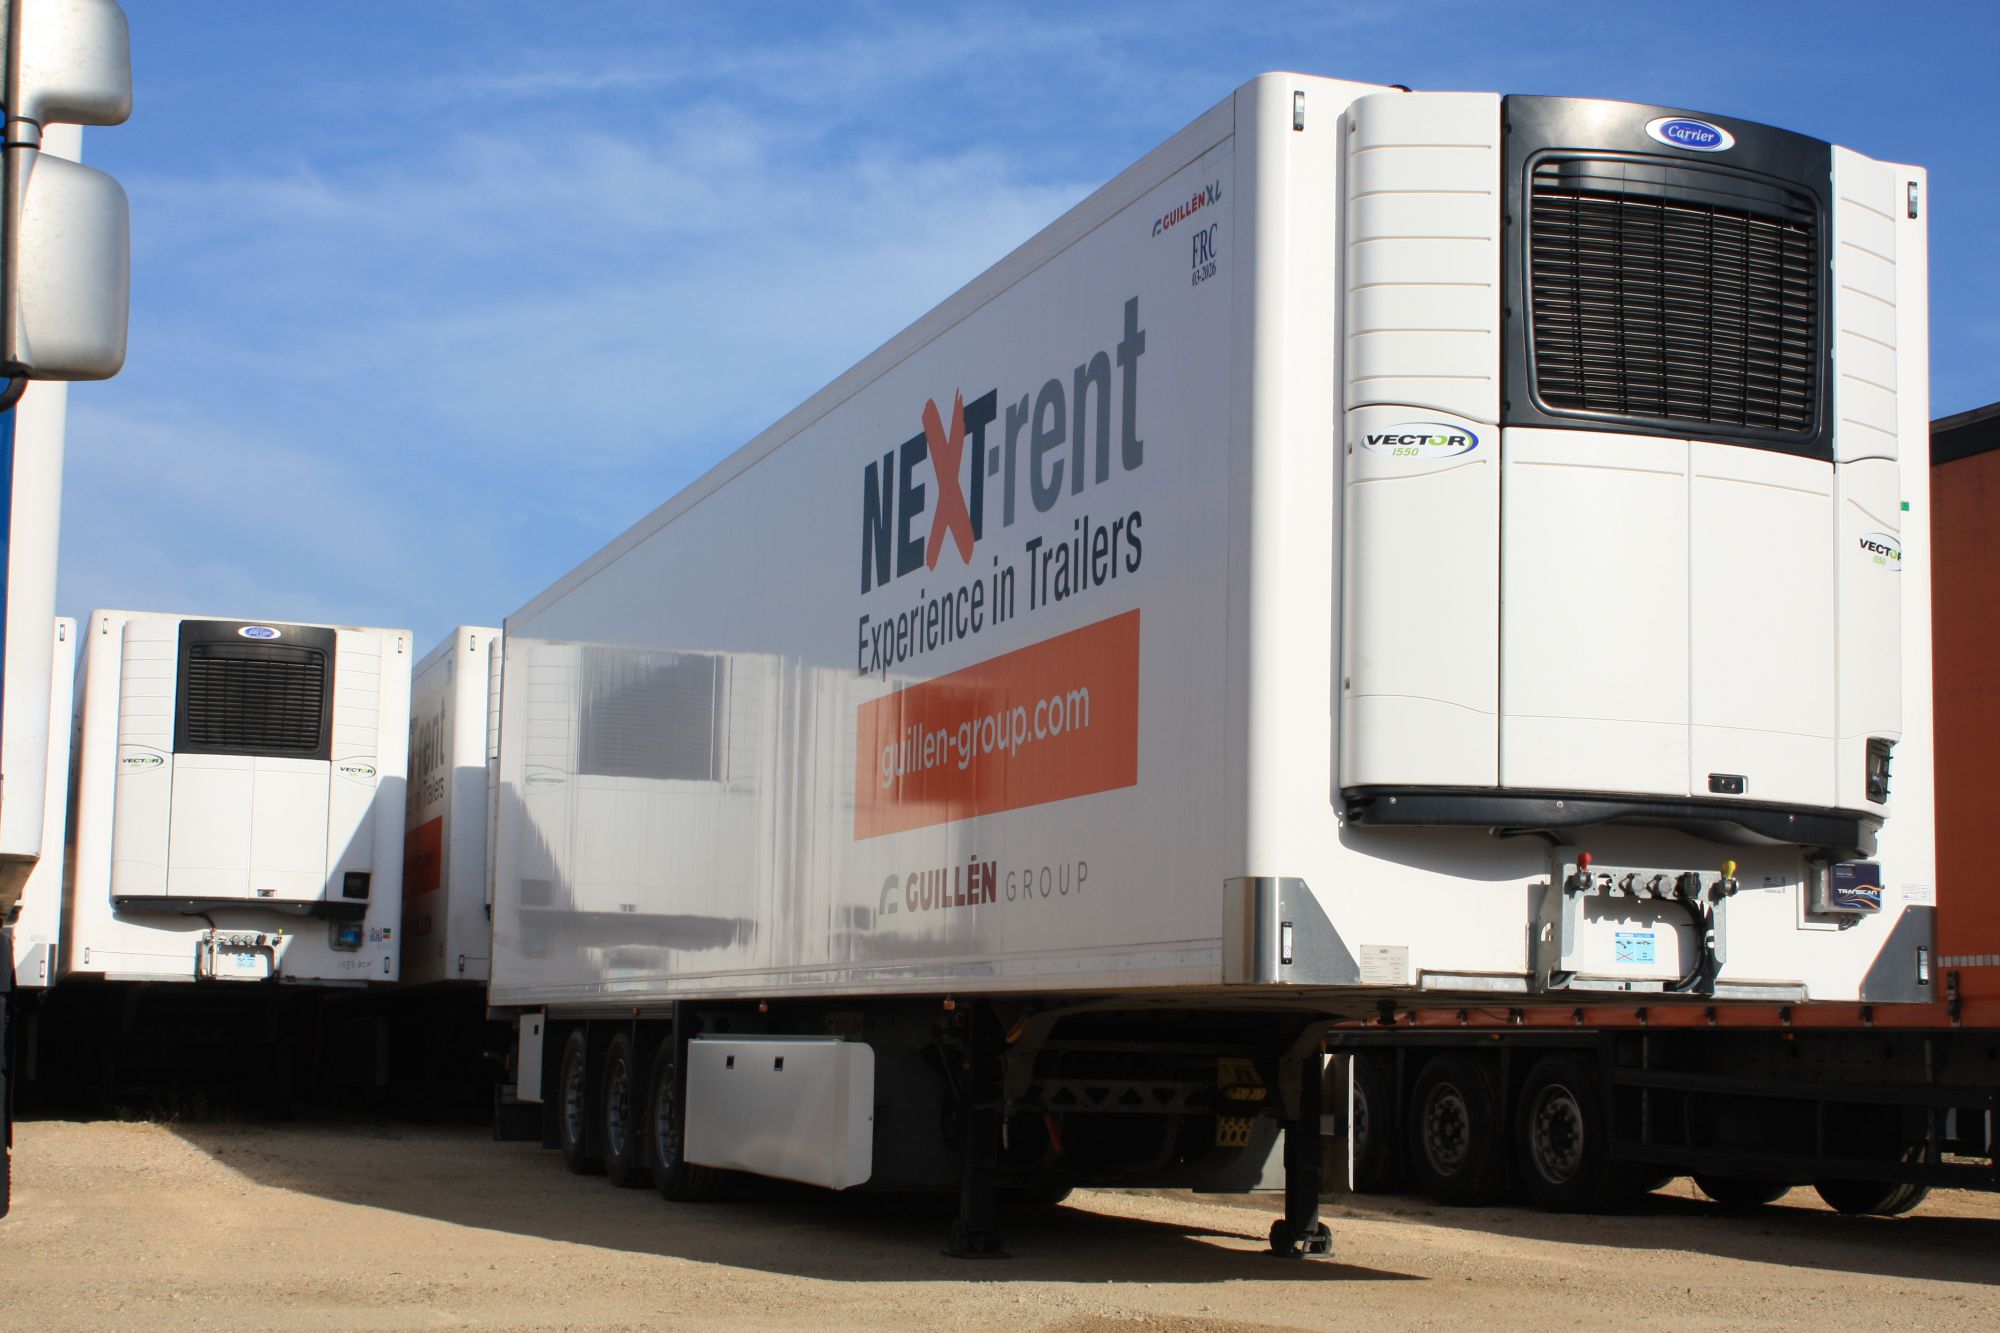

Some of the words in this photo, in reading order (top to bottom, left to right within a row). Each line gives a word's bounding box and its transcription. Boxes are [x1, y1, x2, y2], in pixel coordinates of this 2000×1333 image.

[1668, 126, 1715, 143] Carrier
[1205, 179, 1222, 207] XL
[1192, 222, 1218, 269] FRC
[861, 295, 1146, 595] NEXT-rent
[1366, 434, 1466, 447] VECTOR
[1392, 447, 1419, 456] 1550
[857, 578, 985, 682] Experience
[992, 555, 1015, 626] in
[1025, 510, 1143, 612] Trailers
[881, 685, 1090, 789] guillen-group.com
[1006, 861, 1088, 902] GROUP
